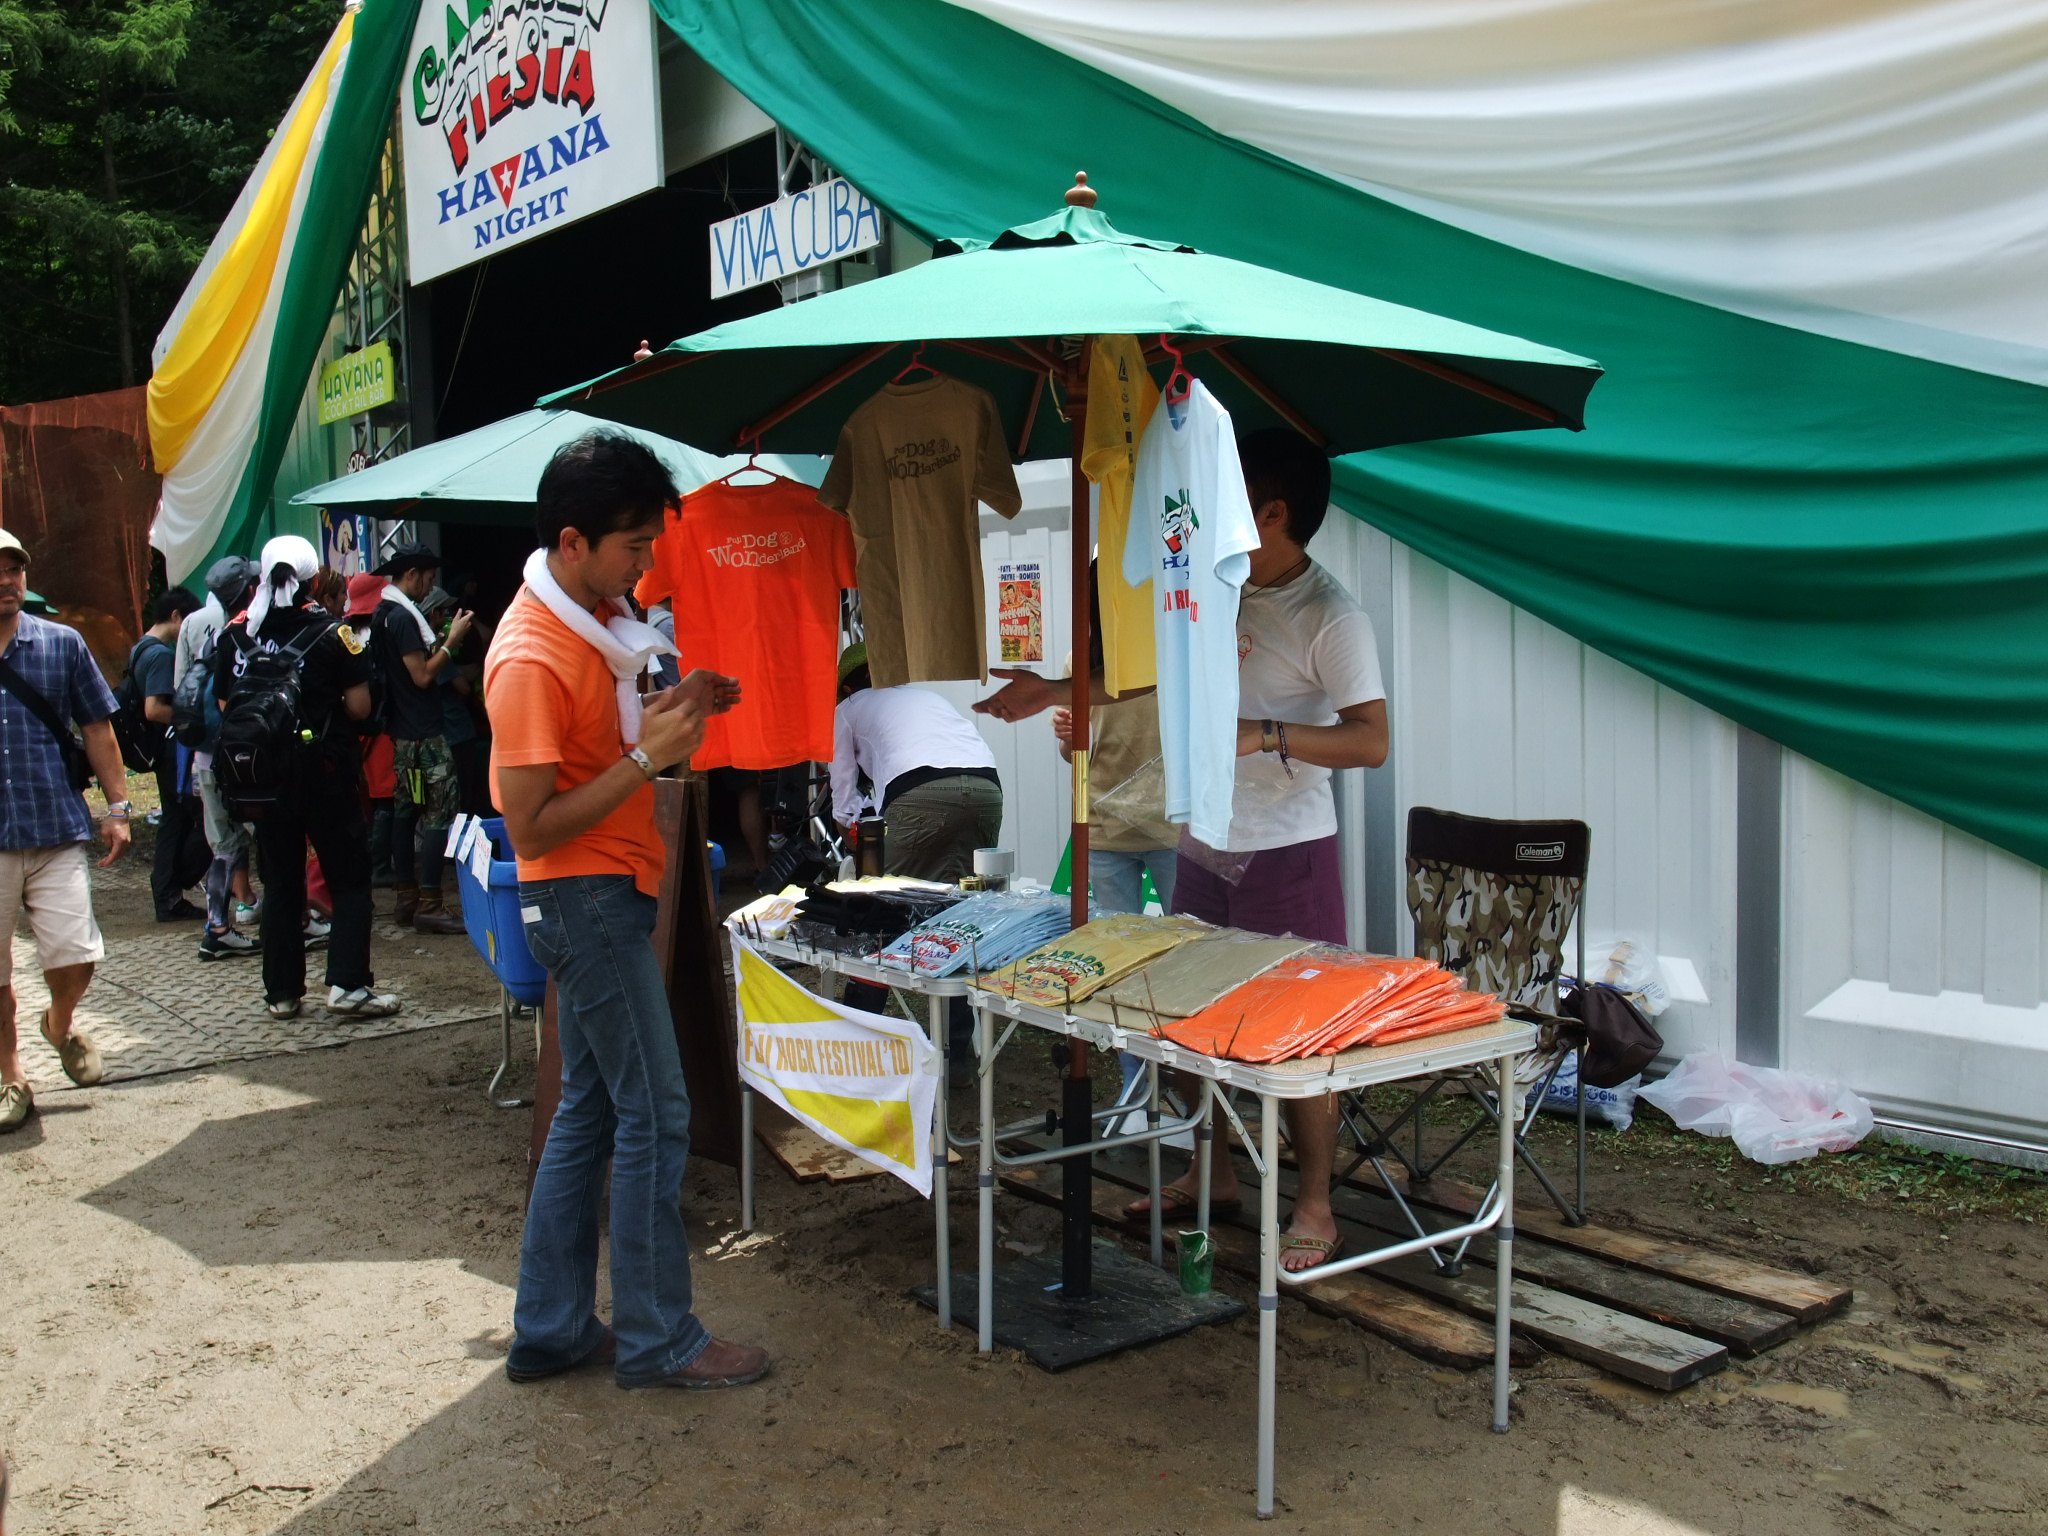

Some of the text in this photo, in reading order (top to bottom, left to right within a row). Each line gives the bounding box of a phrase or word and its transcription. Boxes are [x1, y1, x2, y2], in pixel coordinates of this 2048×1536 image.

[442, 16, 595, 177] FIESTA
[437, 113, 610, 225] HAVANA
[474, 186, 569, 250] NIGHT
[791, 180, 880, 268] CUBA
[324, 357, 384, 402] HAVANA
[707, 538, 806, 568] Wonderland
[742, 532, 778, 549] Dog
[1519, 846, 1553, 856] Coleman
[776, 1036, 817, 1074] ROCK
